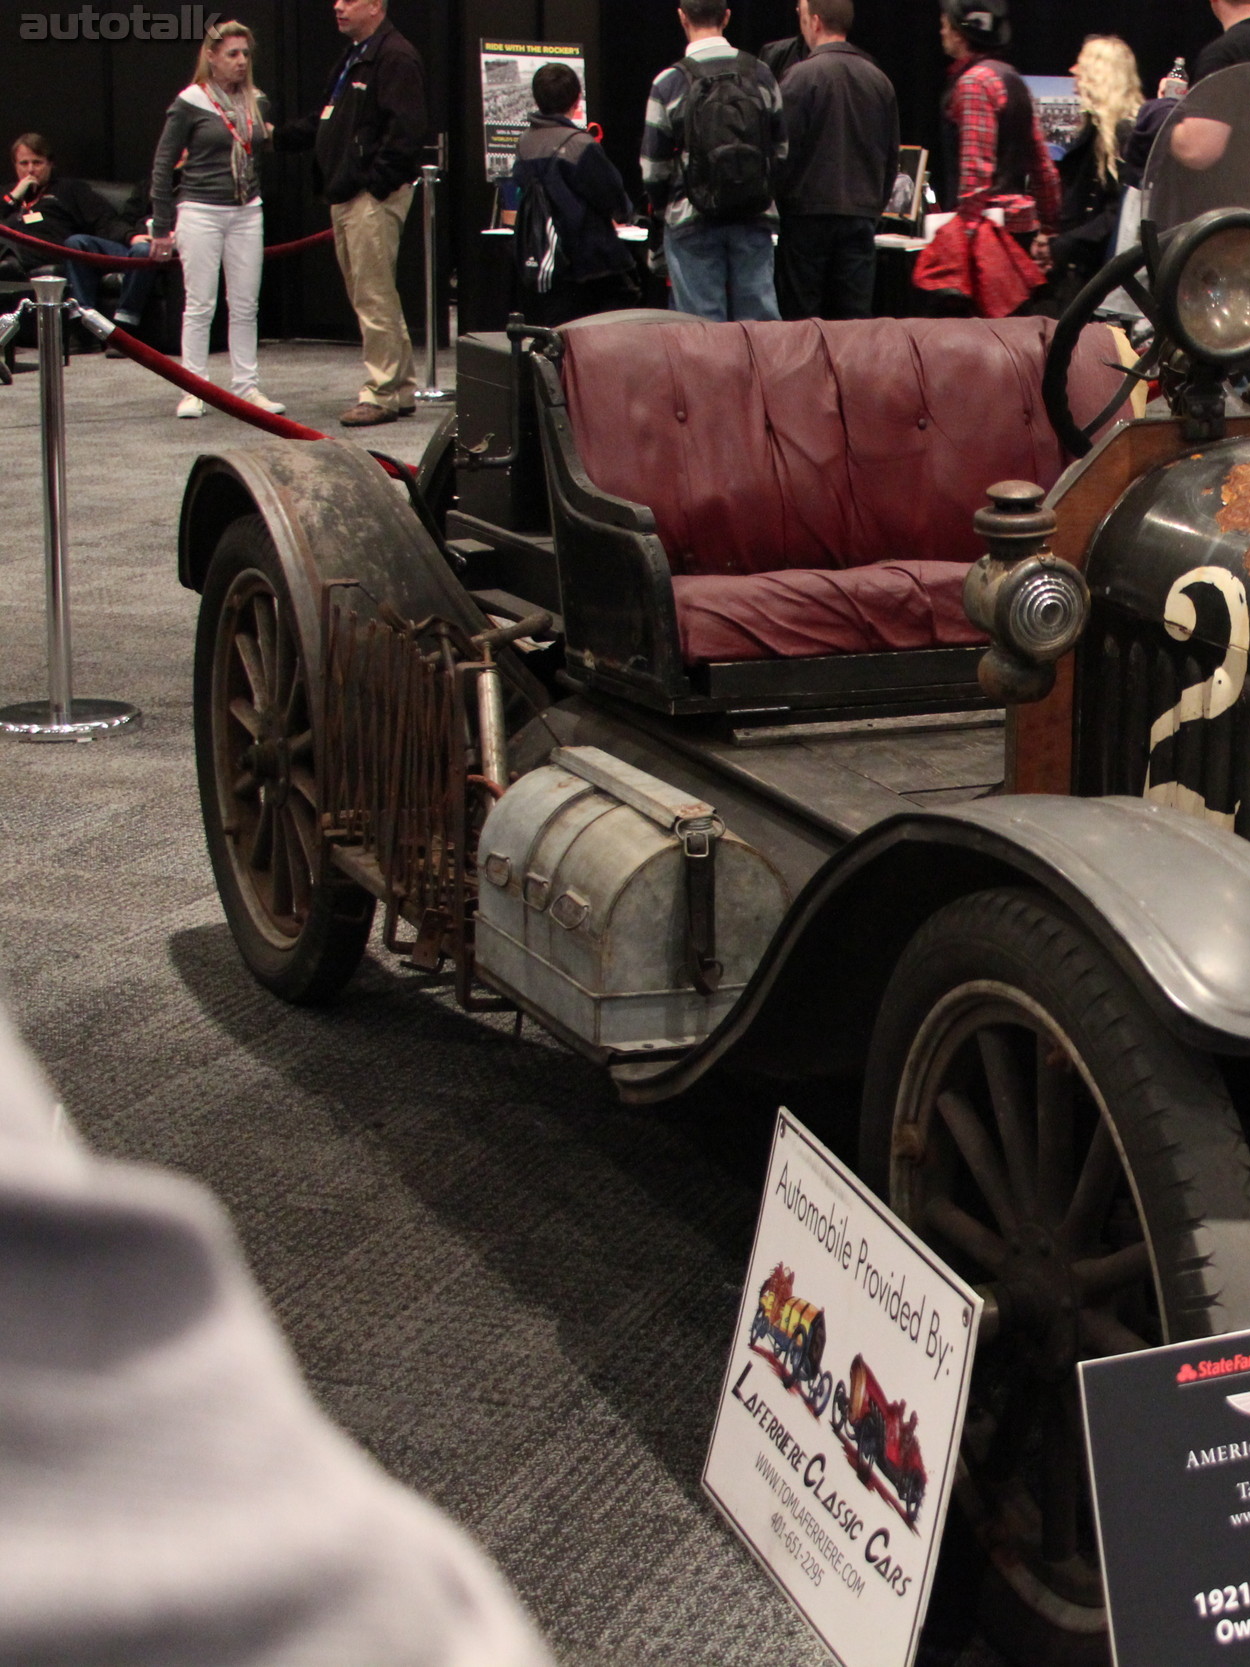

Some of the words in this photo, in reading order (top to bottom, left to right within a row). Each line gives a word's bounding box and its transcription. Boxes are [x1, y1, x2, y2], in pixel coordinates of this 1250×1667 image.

[485, 43, 503, 52] RIDE
[504, 44, 525, 52] WITH
[526, 45, 542, 53] THE
[542, 46, 580, 55] ROCKER'S
[775, 1159, 853, 1270] Automobile
[855, 1237, 927, 1344] Provided
[925, 1309, 955, 1381] By:
[731, 1360, 807, 1473] LAFERRIERE
[803, 1452, 864, 1541] CLASSIC
[864, 1527, 913, 1597] CARS
[754, 1450, 866, 1599] WWW.TOMLAFERRIERE.COM
[770, 1511, 826, 1588] 401-651-2295
